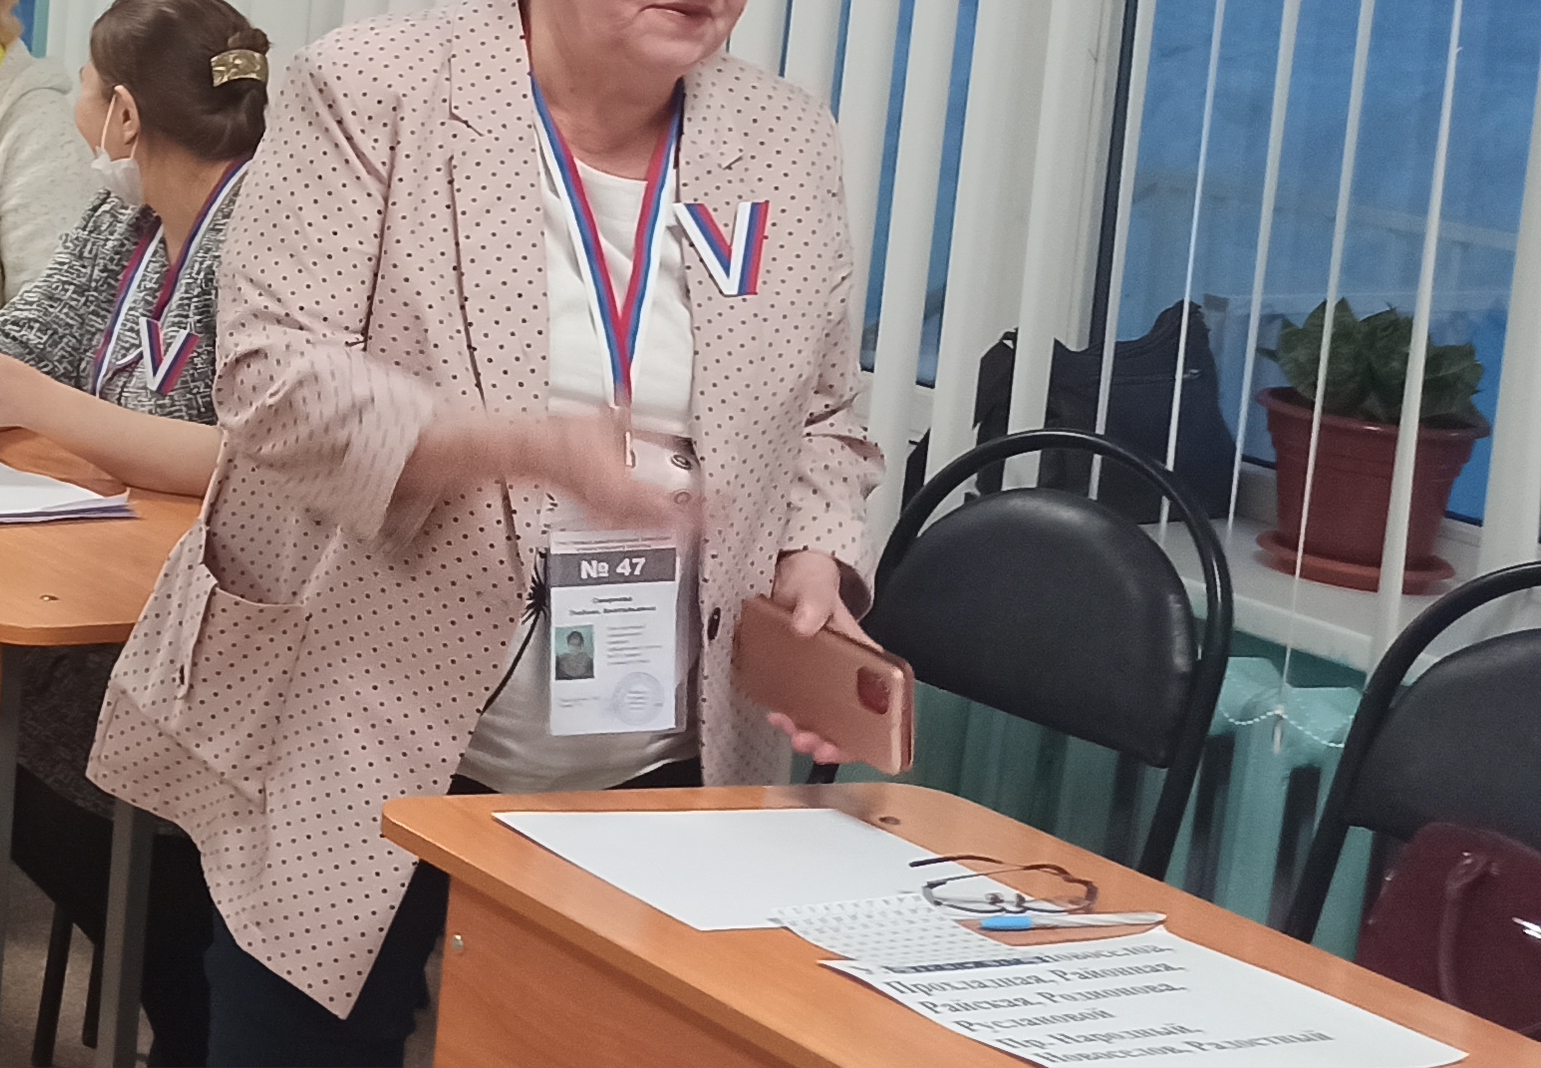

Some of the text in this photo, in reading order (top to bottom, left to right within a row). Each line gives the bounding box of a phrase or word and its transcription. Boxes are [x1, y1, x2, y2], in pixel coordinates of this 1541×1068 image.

[616, 557, 646, 576] 47
[883, 973, 1060, 996] Прохладная,
[1048, 962, 1186, 982] Районная,
[917, 983, 1188, 1014] Райская, Родионова,
[953, 1007, 1116, 1033] Руслановой
[996, 1023, 1205, 1050] Пр. Народный,
[1182, 1030, 1335, 1051] Радостный
